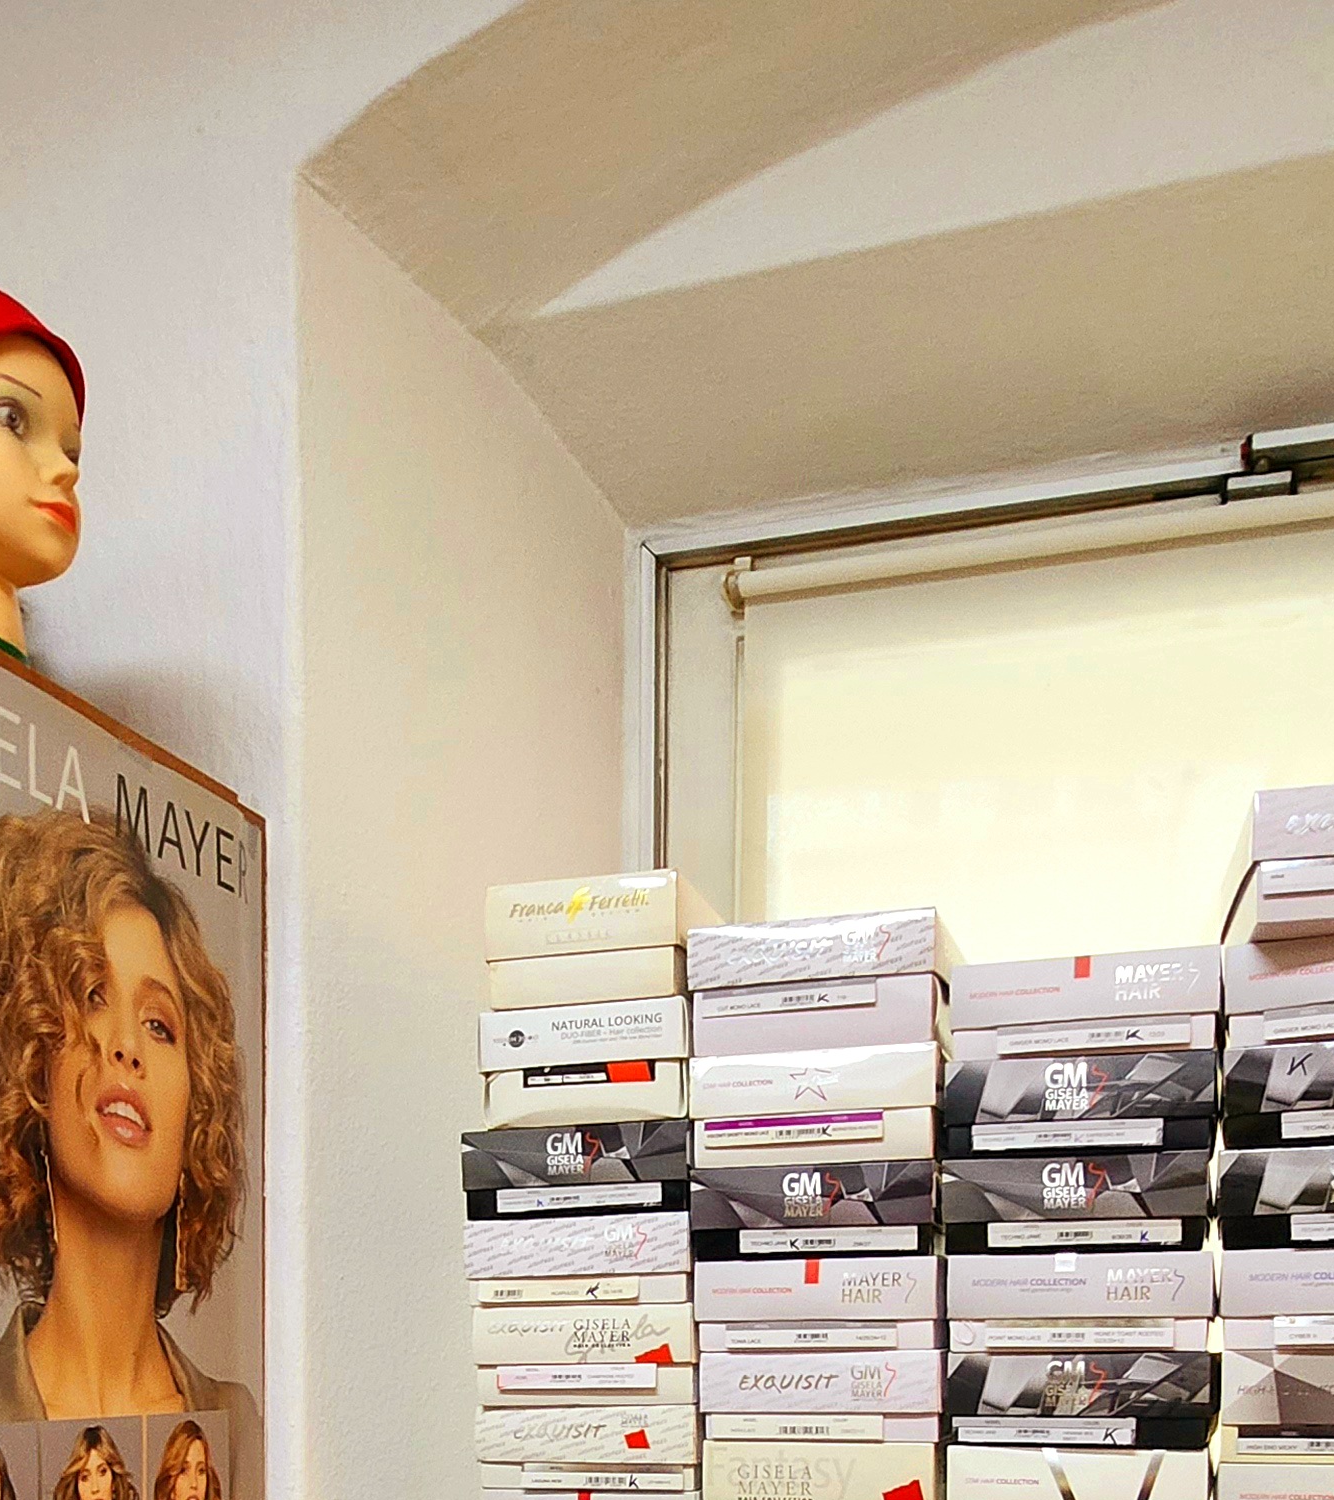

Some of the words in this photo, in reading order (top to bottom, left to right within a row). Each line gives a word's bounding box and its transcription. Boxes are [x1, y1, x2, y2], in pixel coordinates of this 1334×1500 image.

[116, 773, 248, 903] MAYER
[509, 903, 563, 918] Franca
[1016, 987, 1060, 996] COLLECTION
[552, 1018, 604, 1031] NATURAL
[608, 1013, 662, 1027] LOOKING
[627, 1025, 662, 1034] collection
[1287, 1053, 1313, 1076] K
[1045, 1062, 1087, 1088] GM
[1045, 1088, 1089, 1100] GISELA
[1045, 1099, 1089, 1111] MAYER
[547, 1155, 584, 1166] GISELA
[547, 1165, 584, 1175] MAYER
[1042, 1162, 1085, 1187] GM
[782, 1172, 823, 1197] GM
[1042, 1187, 1086, 1199] GISELA
[1043, 1198, 1086, 1209] MAYER
[842, 1272, 901, 1287] MAYER
[1030, 1277, 1087, 1286] COLLECTION
[841, 1288, 882, 1304] HAIR
[1106, 1286, 1151, 1301] HAIR
[573, 1319, 630, 1330] GISELA
[739, 1374, 839, 1393] EXQUISIT
[737, 1464, 812, 1480] GISELA
[738, 1480, 813, 1495] MAYER
